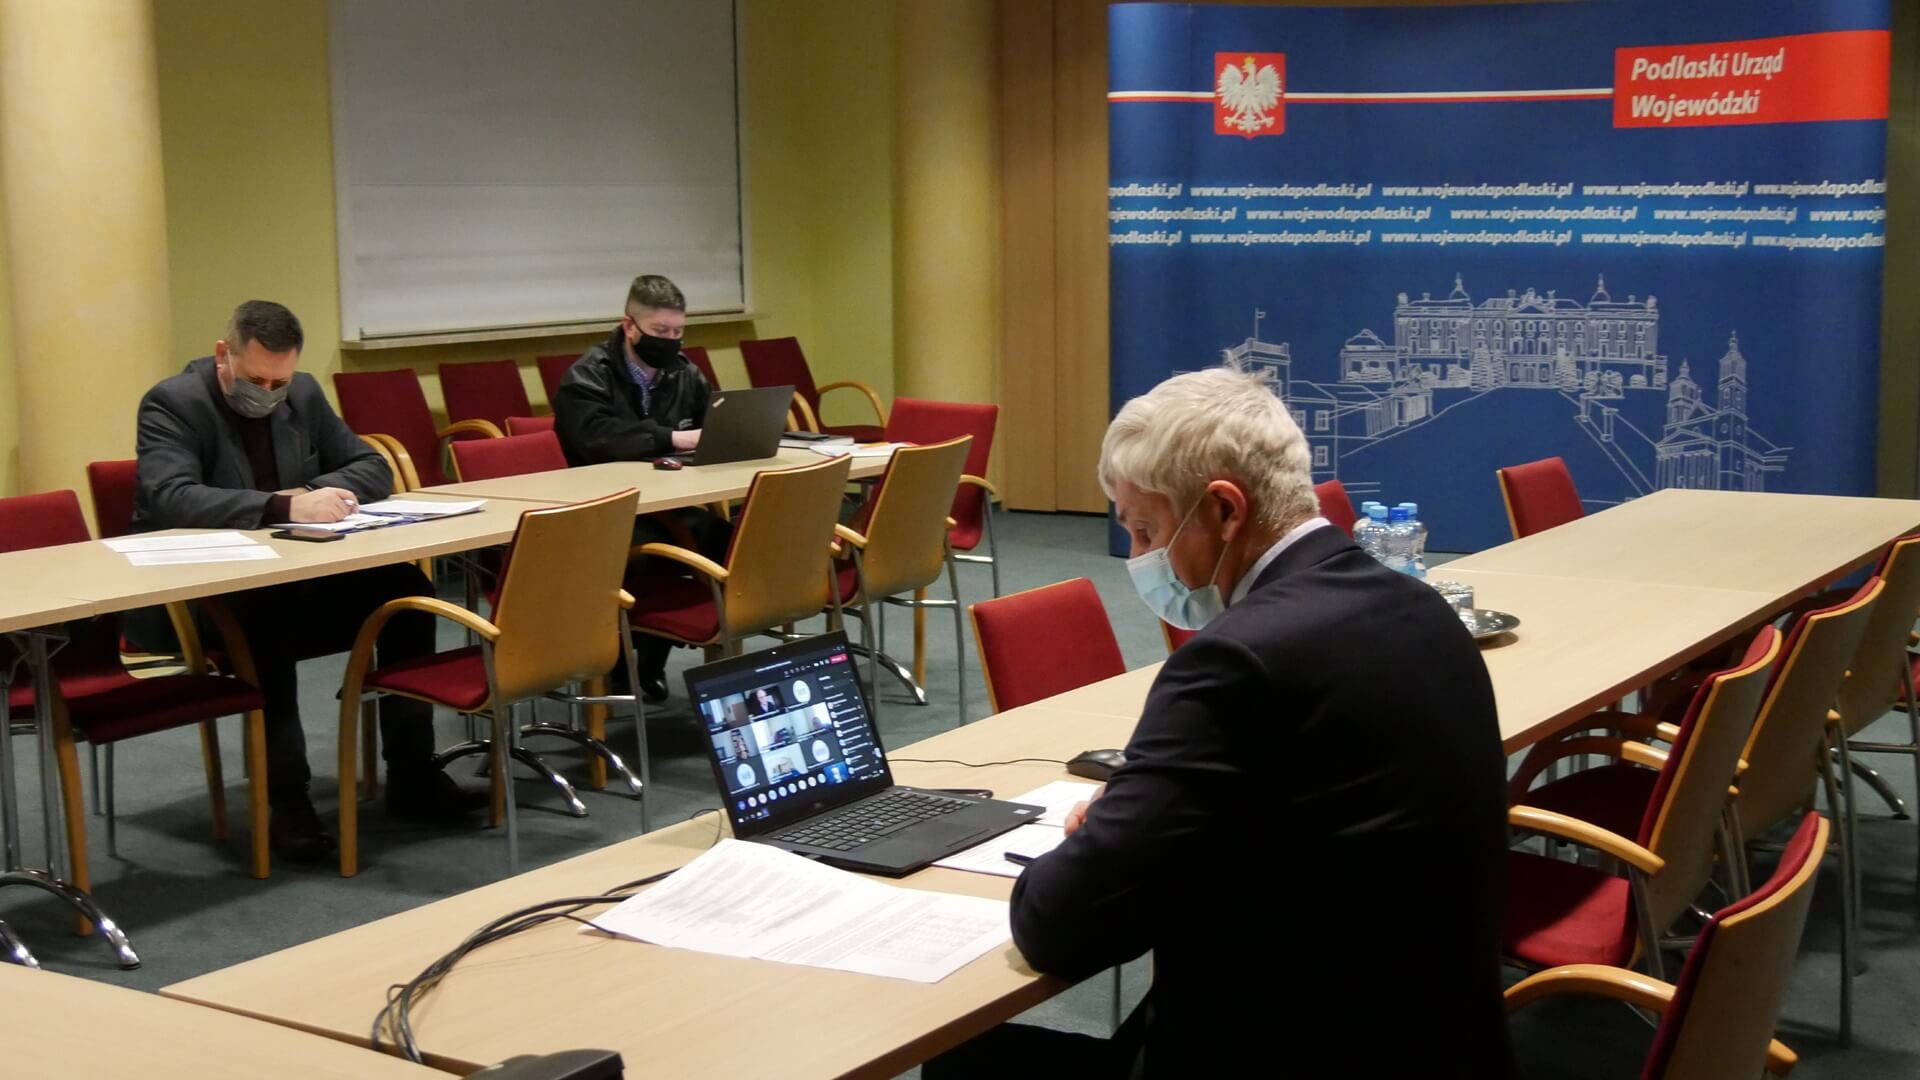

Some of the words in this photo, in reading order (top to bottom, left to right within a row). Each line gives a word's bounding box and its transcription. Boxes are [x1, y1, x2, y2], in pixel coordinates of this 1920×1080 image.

[1631, 52, 1729, 81] Podlaski
[1732, 46, 1785, 80] Urząd
[1631, 89, 1761, 123] Wojewódzki
[1190, 183, 1372, 199] www.wojewodapodlaski.pl
[1382, 183, 1574, 199] www.wojewodapodlaski.pl
[1583, 182, 1749, 198] www.wojewodapodlaski.pl
[1246, 207, 1432, 222] www.wojewodapodlaski.pl
[1450, 206, 1638, 222] www.wojewodapodlaski.pl
[1654, 206, 1798, 224] www.wojewodapodlaski.pl
[1190, 230, 1371, 246] www.wojewodapodlaski.pl
[1381, 230, 1572, 246] www.wojewodapodlaski.pl
[1581, 230, 1747, 248] www.wojewodapodlaski.pl
